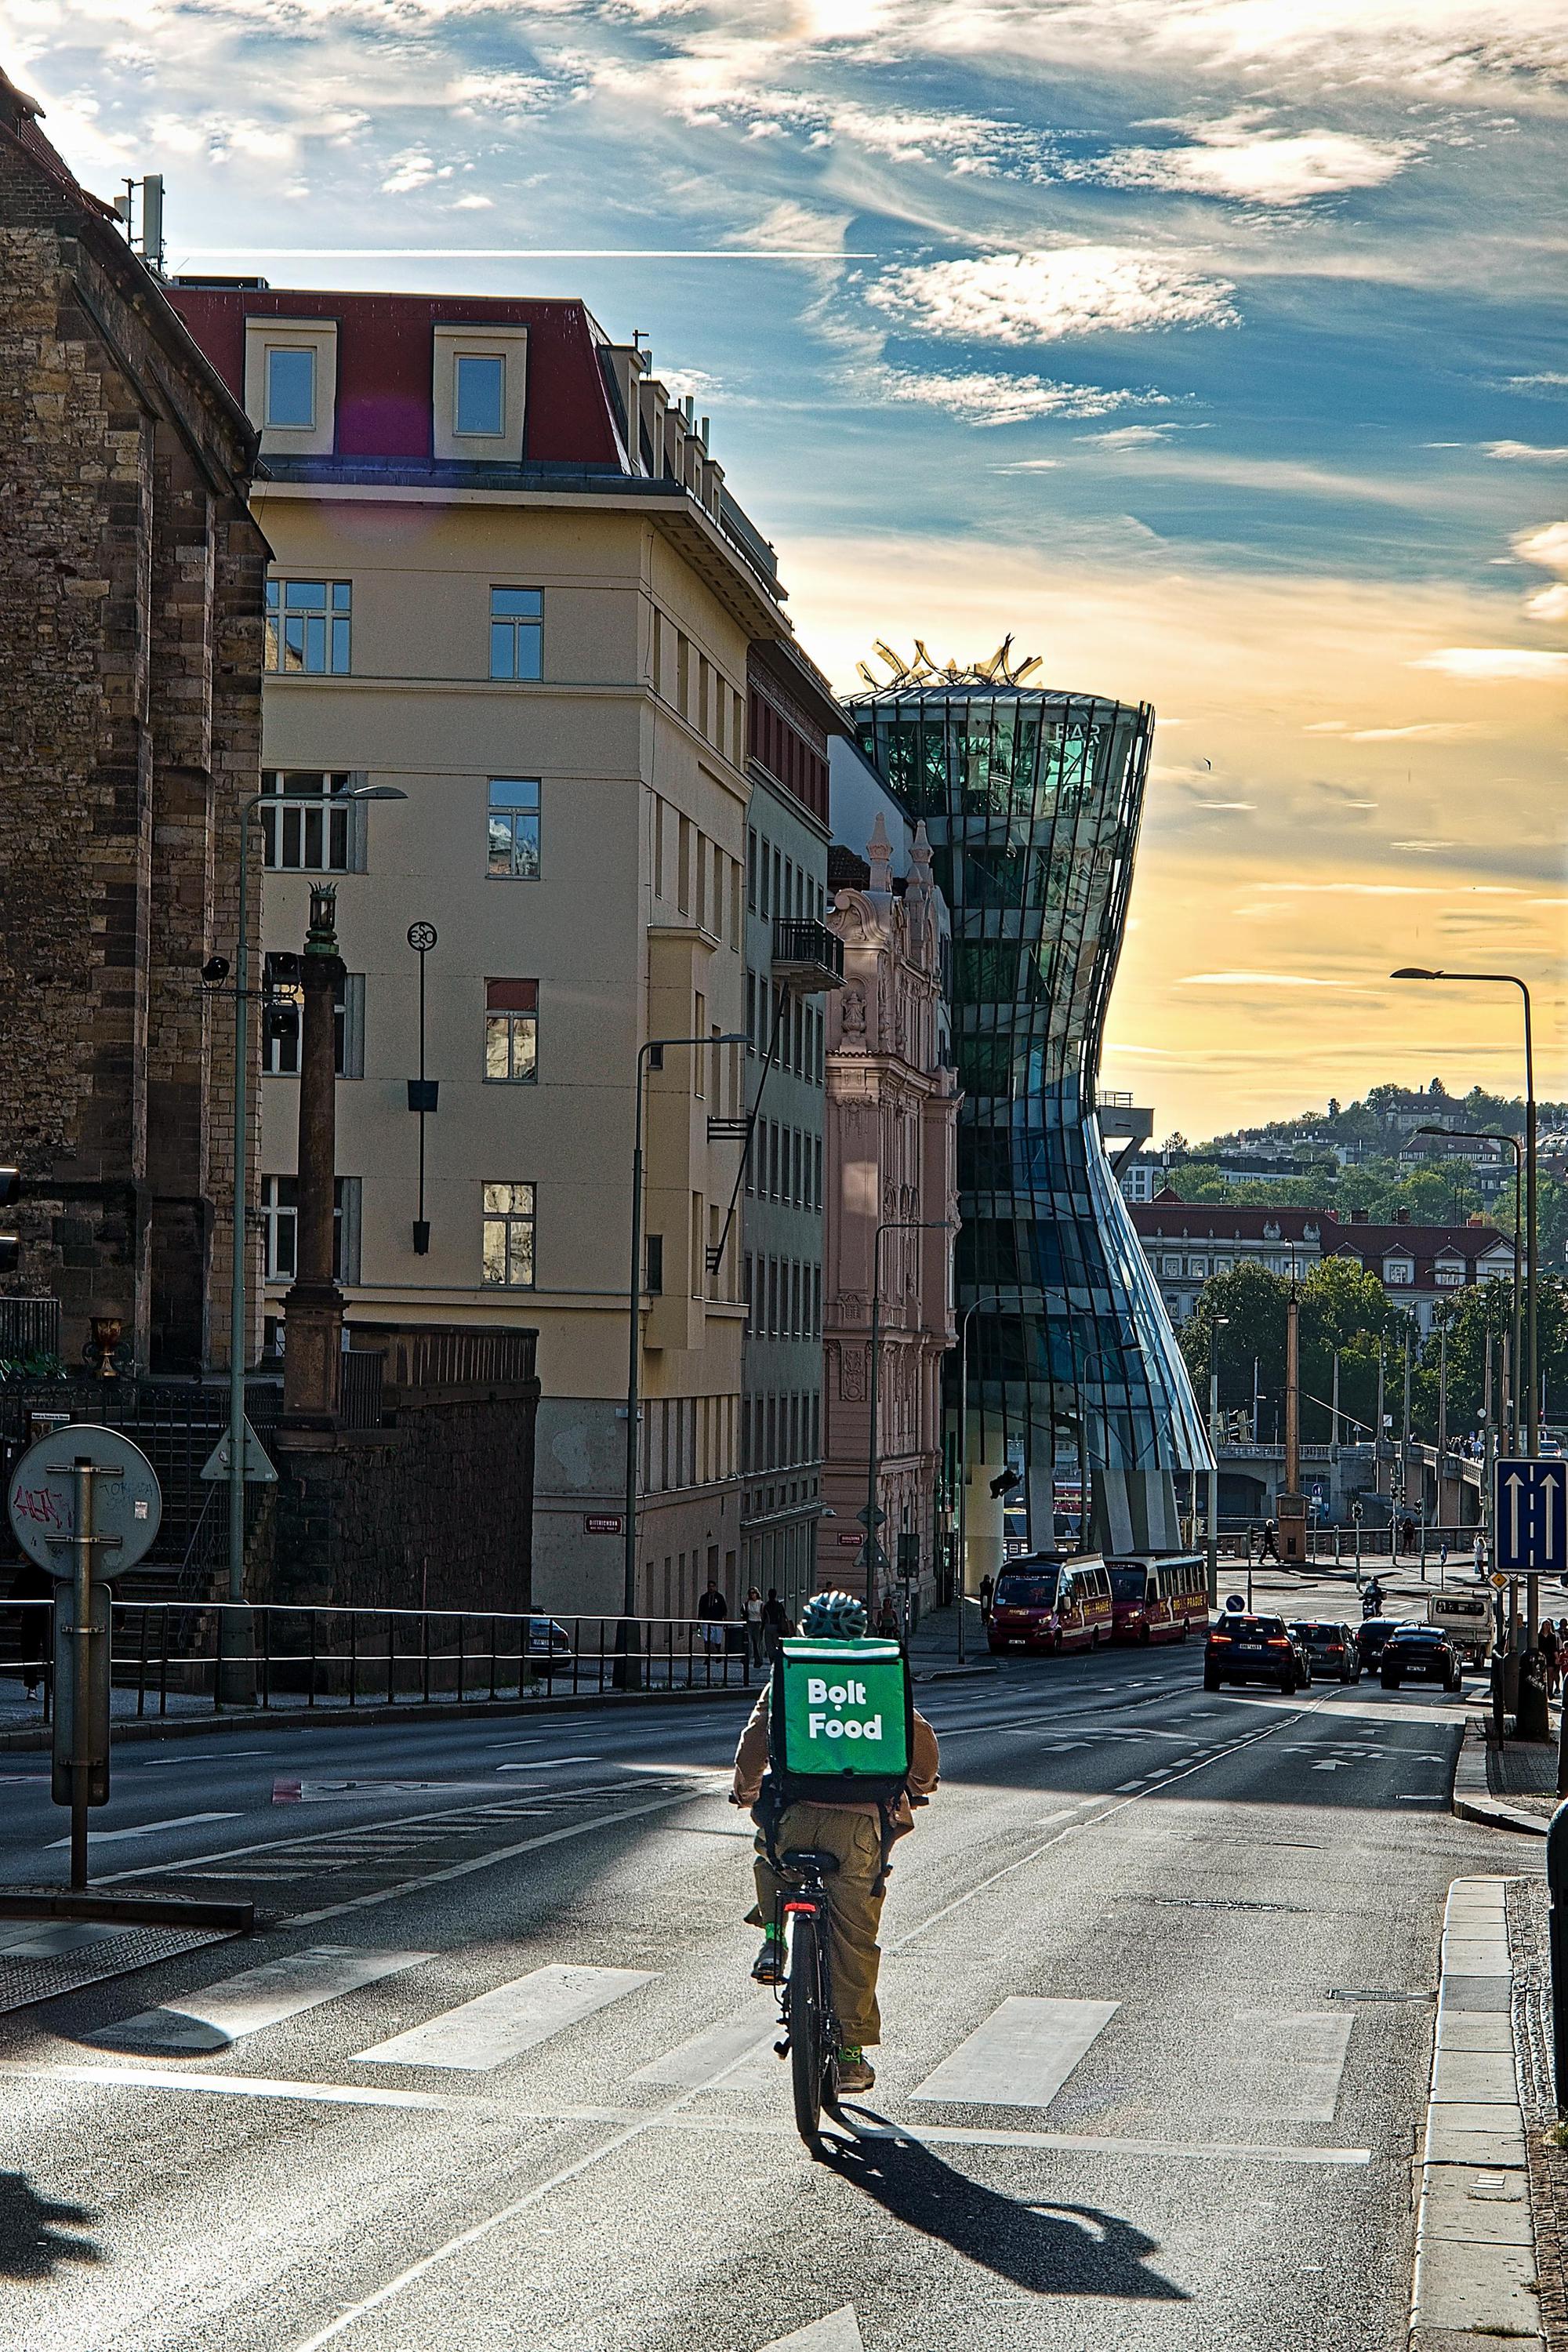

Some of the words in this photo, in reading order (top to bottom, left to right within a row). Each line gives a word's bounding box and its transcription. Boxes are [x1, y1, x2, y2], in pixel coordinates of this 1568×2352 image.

[1186, 1595, 1203, 1609] PRAGUE
[808, 1679, 866, 1711] Bolt
[808, 1713, 883, 1740] Food
